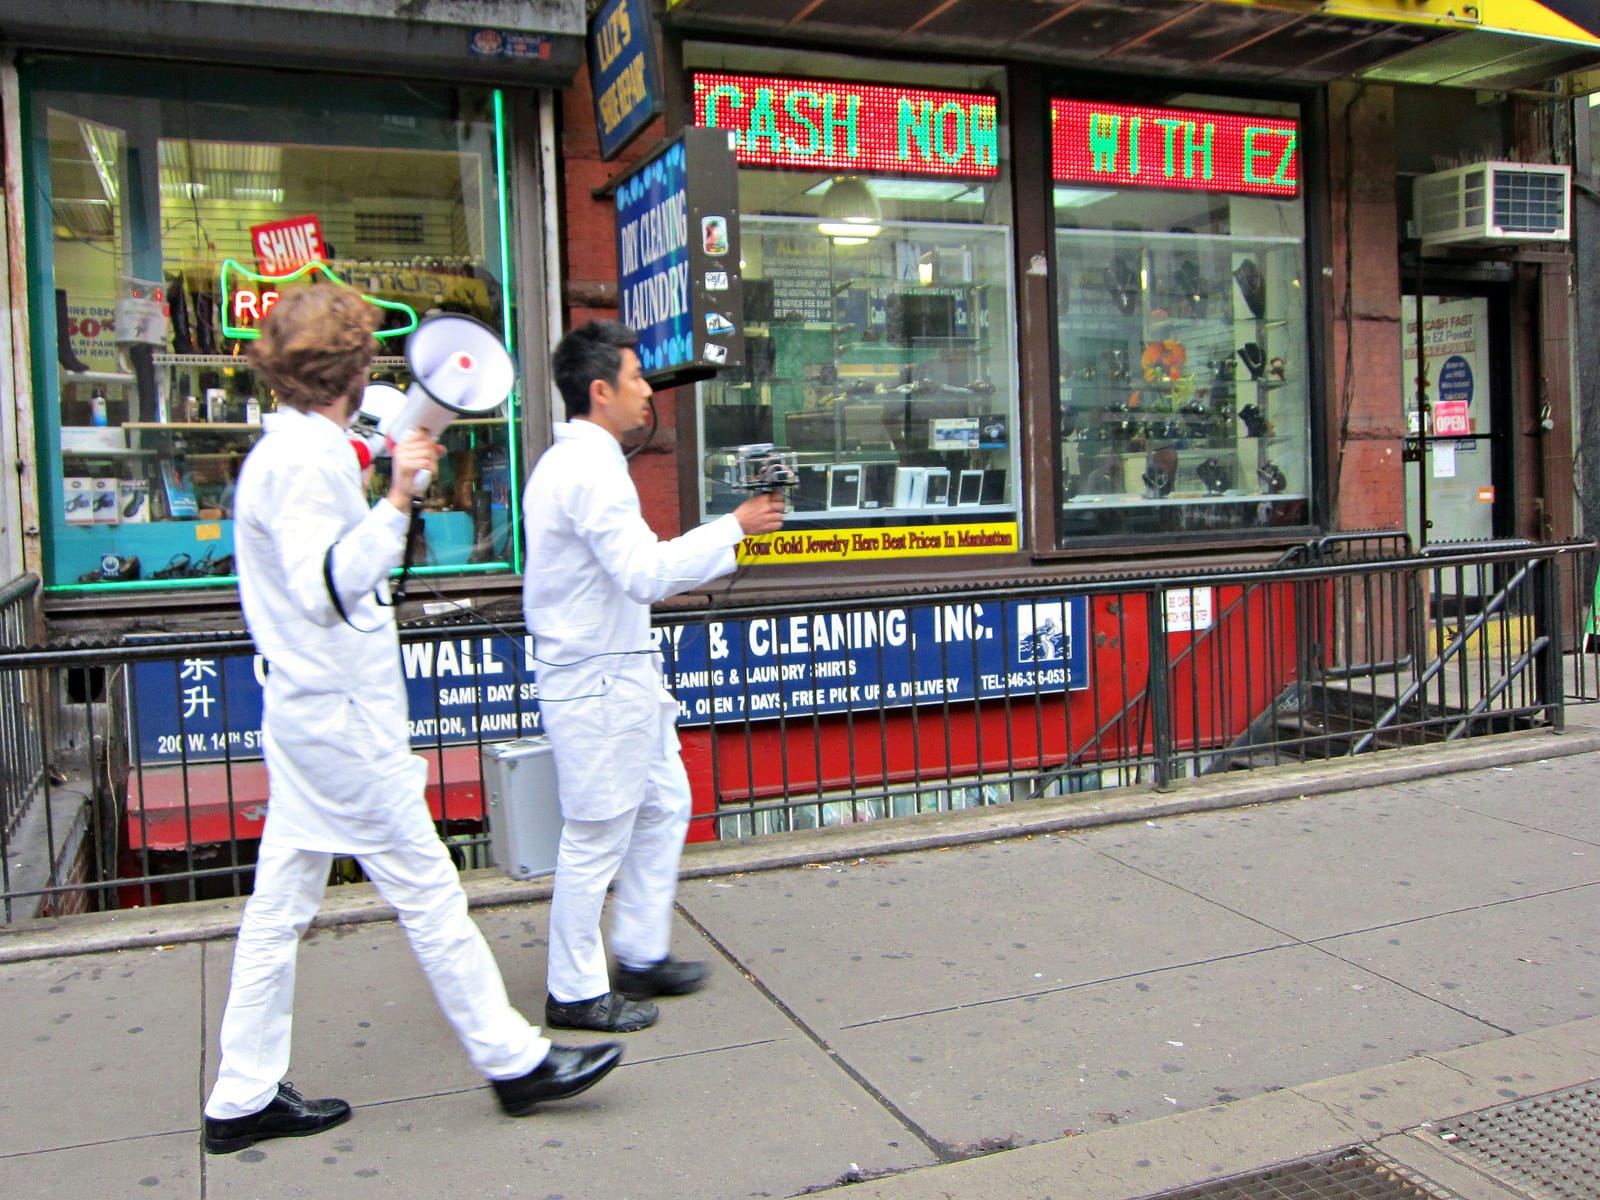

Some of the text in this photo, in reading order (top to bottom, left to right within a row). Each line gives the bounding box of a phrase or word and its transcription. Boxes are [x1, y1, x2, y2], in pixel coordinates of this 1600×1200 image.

[705, 85, 997, 167] CASH NOW
[1089, 113, 1296, 186] WITH EZ
[258, 222, 322, 273] SHINE
[621, 188, 688, 276] DRY CLEANING
[624, 260, 689, 331] LAUNDRY
[1436, 414, 1467, 433] OPEN
[743, 537, 772, 556] Your
[774, 535, 803, 555] Gold
[806, 534, 849, 557] Jewelry
[852, 533, 879, 551] Here
[881, 532, 907, 550] Best
[908, 531, 942, 549] Prices
[944, 530, 956, 548] In
[958, 529, 1013, 547] Manhattan
[401, 635, 503, 679] WALL
[709, 622, 729, 659] &
[935, 602, 993, 643] INC.
[487, 685, 515, 702] DAY
[729, 668, 740, 684] &
[747, 663, 806, 683] LAUNDRY
[738, 696, 746, 712] 7
[886, 683, 897, 699] &
[188, 733, 207, 752] W.
